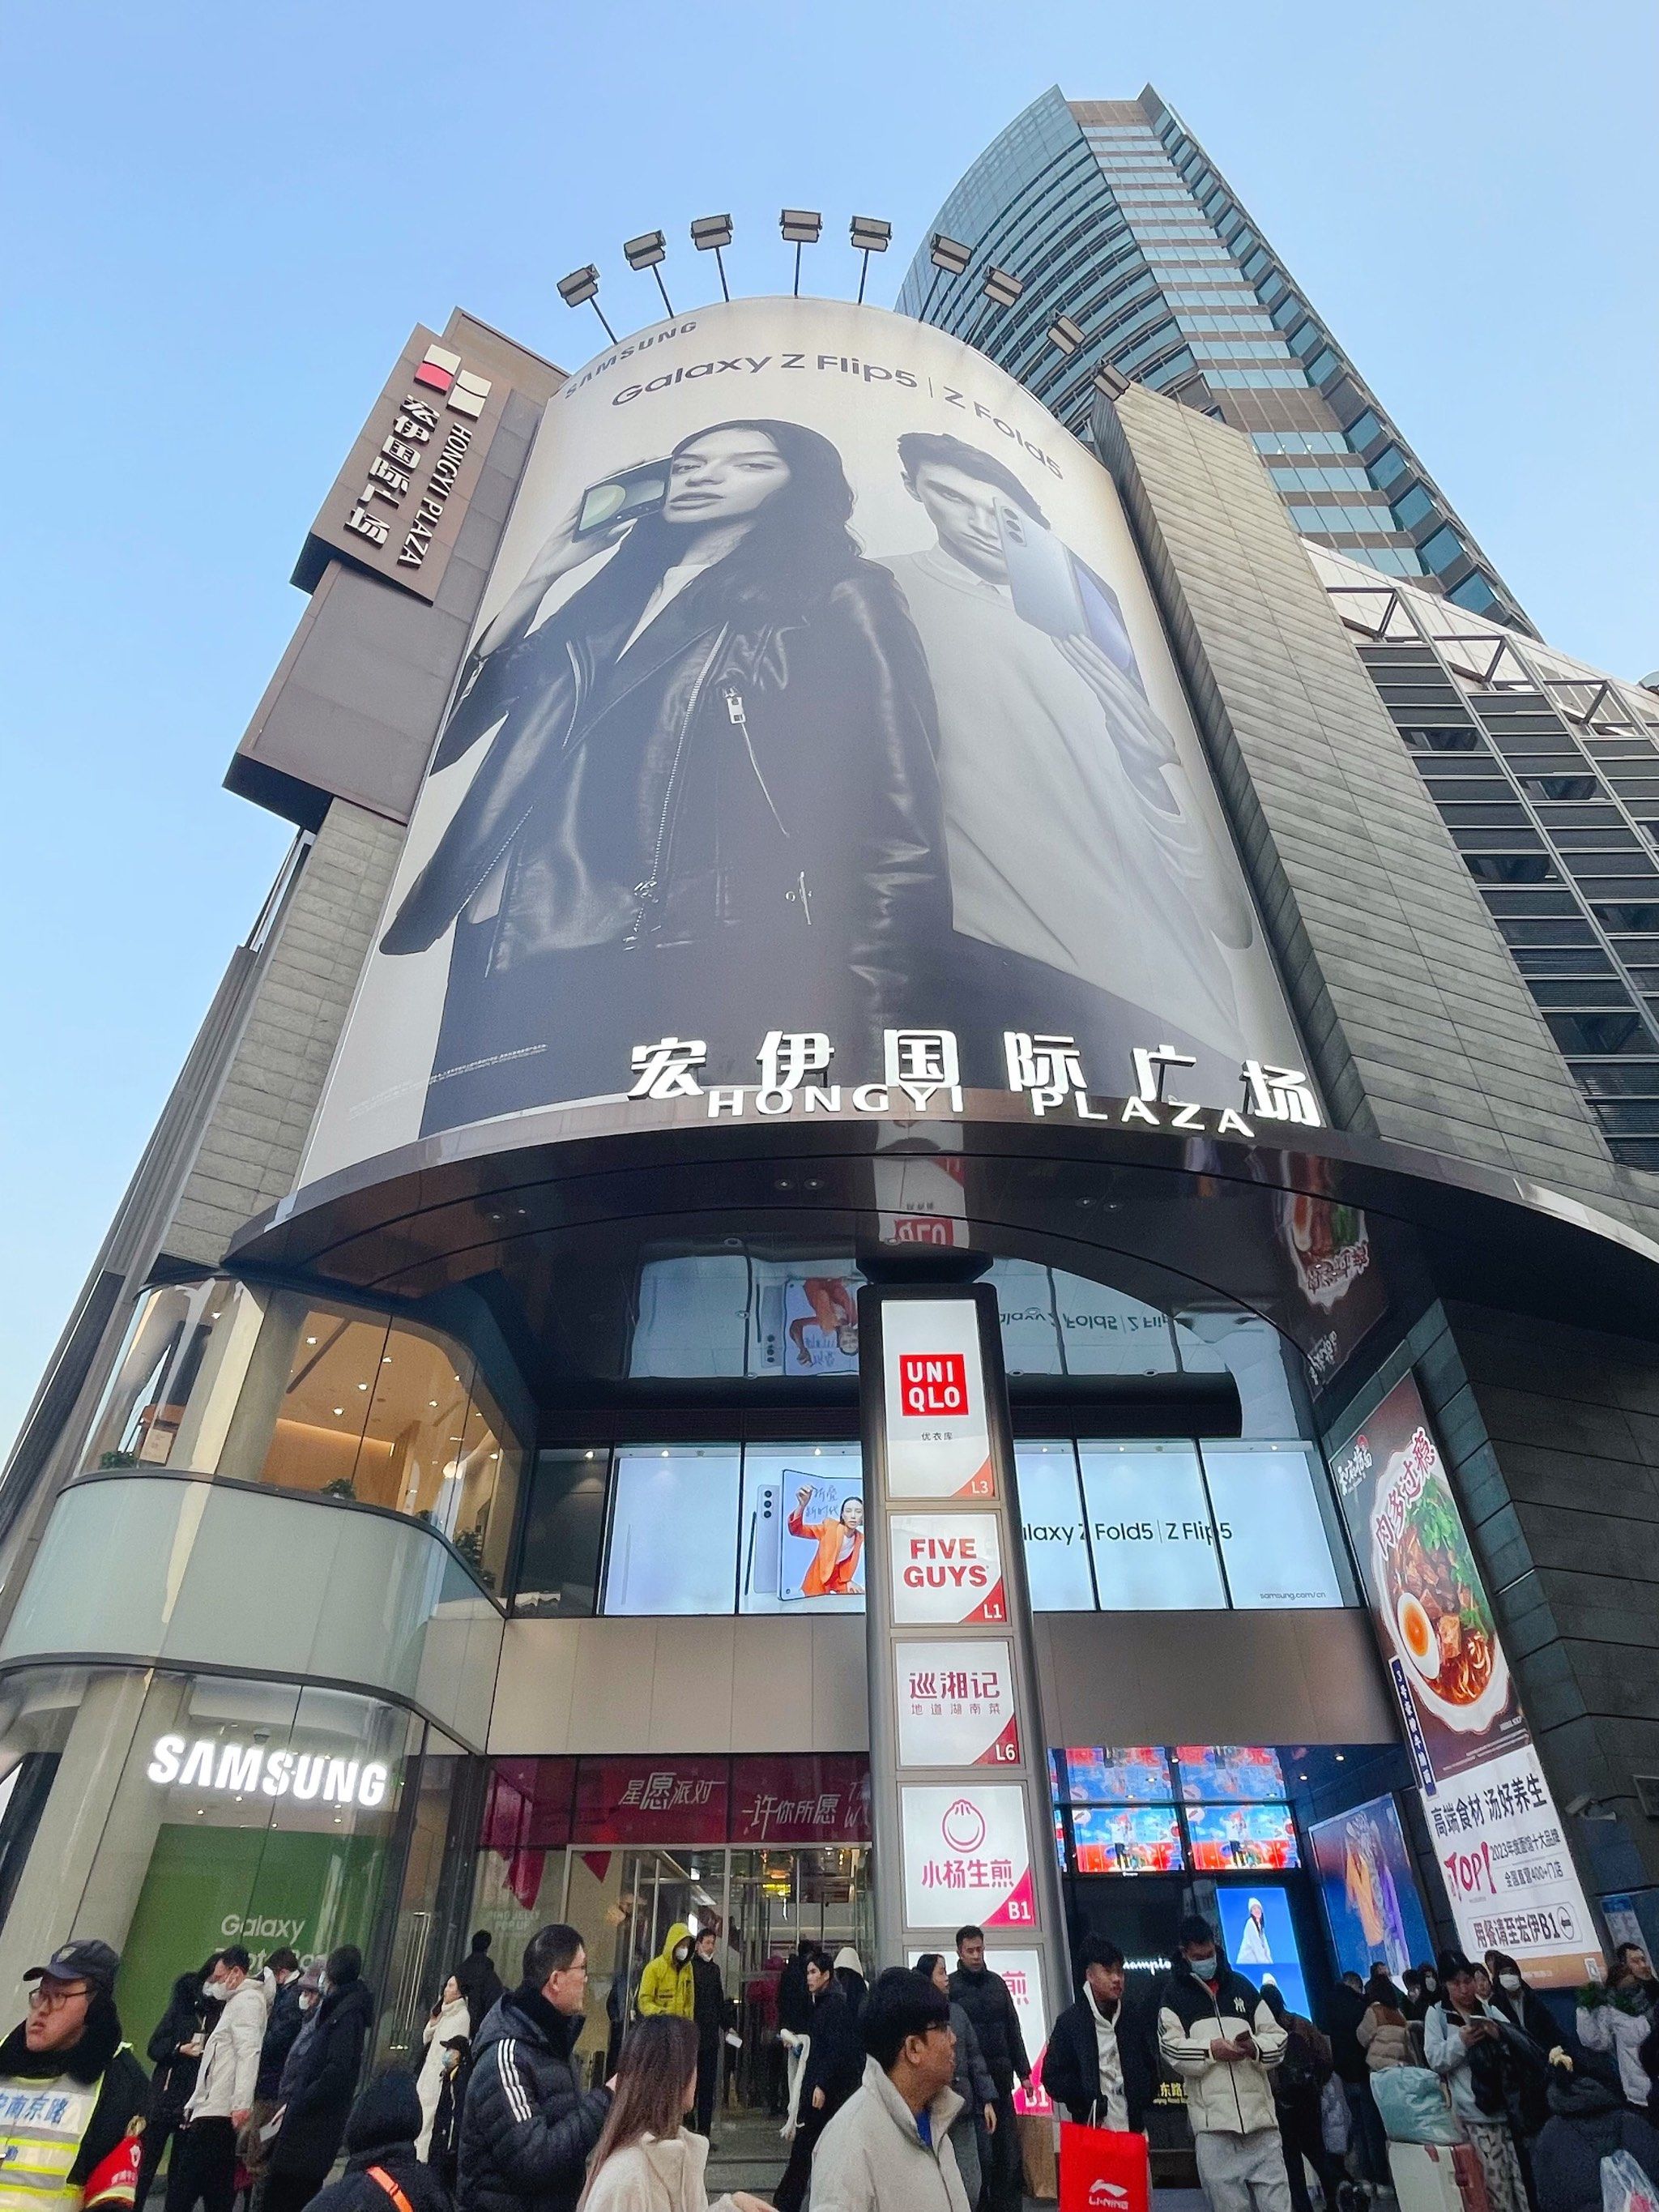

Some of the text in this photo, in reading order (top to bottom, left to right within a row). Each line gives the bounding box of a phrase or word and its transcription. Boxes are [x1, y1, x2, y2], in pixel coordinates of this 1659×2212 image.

[565, 322, 697, 399] SAMSUNG
[612, 353, 1063, 480] Galaxy Z Flip5 Z Fold5
[343, 394, 440, 545] 宏伊国际广场
[399, 422, 472, 566] HONGYI PLAZA
[627, 1029, 1321, 1127] 宏伊国际广场
[707, 1083, 1255, 1138] HONGYI PLAZA
[906, 1361, 954, 1382] UNI
[908, 1386, 961, 1411] QLO
[921, 1431, 953, 1441] 优衣库
[972, 1480, 989, 1494] L3
[1095, 1522, 1153, 1539] Fold5
[1166, 1523, 1179, 1539] Z
[910, 1538, 977, 1560] FIVE
[903, 1565, 987, 1588] GUYS
[983, 1603, 1003, 1619] L1
[909, 1672, 1000, 1700] 巡湘记
[911, 1703, 1001, 1716] 地道湖南菜
[996, 1743, 1016, 1761] L6
[147, 1736, 388, 1806] SAMSUNG
[618, 1772, 726, 1810] 星愿派对
[1431, 1773, 1546, 1839] 高端食材 汤好养生
[922, 1860, 1014, 1889] 小杨生煎
[1008, 1901, 1031, 1920] B1
[221, 1915, 306, 1945] Galaxy
[1473, 1911, 1560, 1948] 用餐请至宏伊B1
